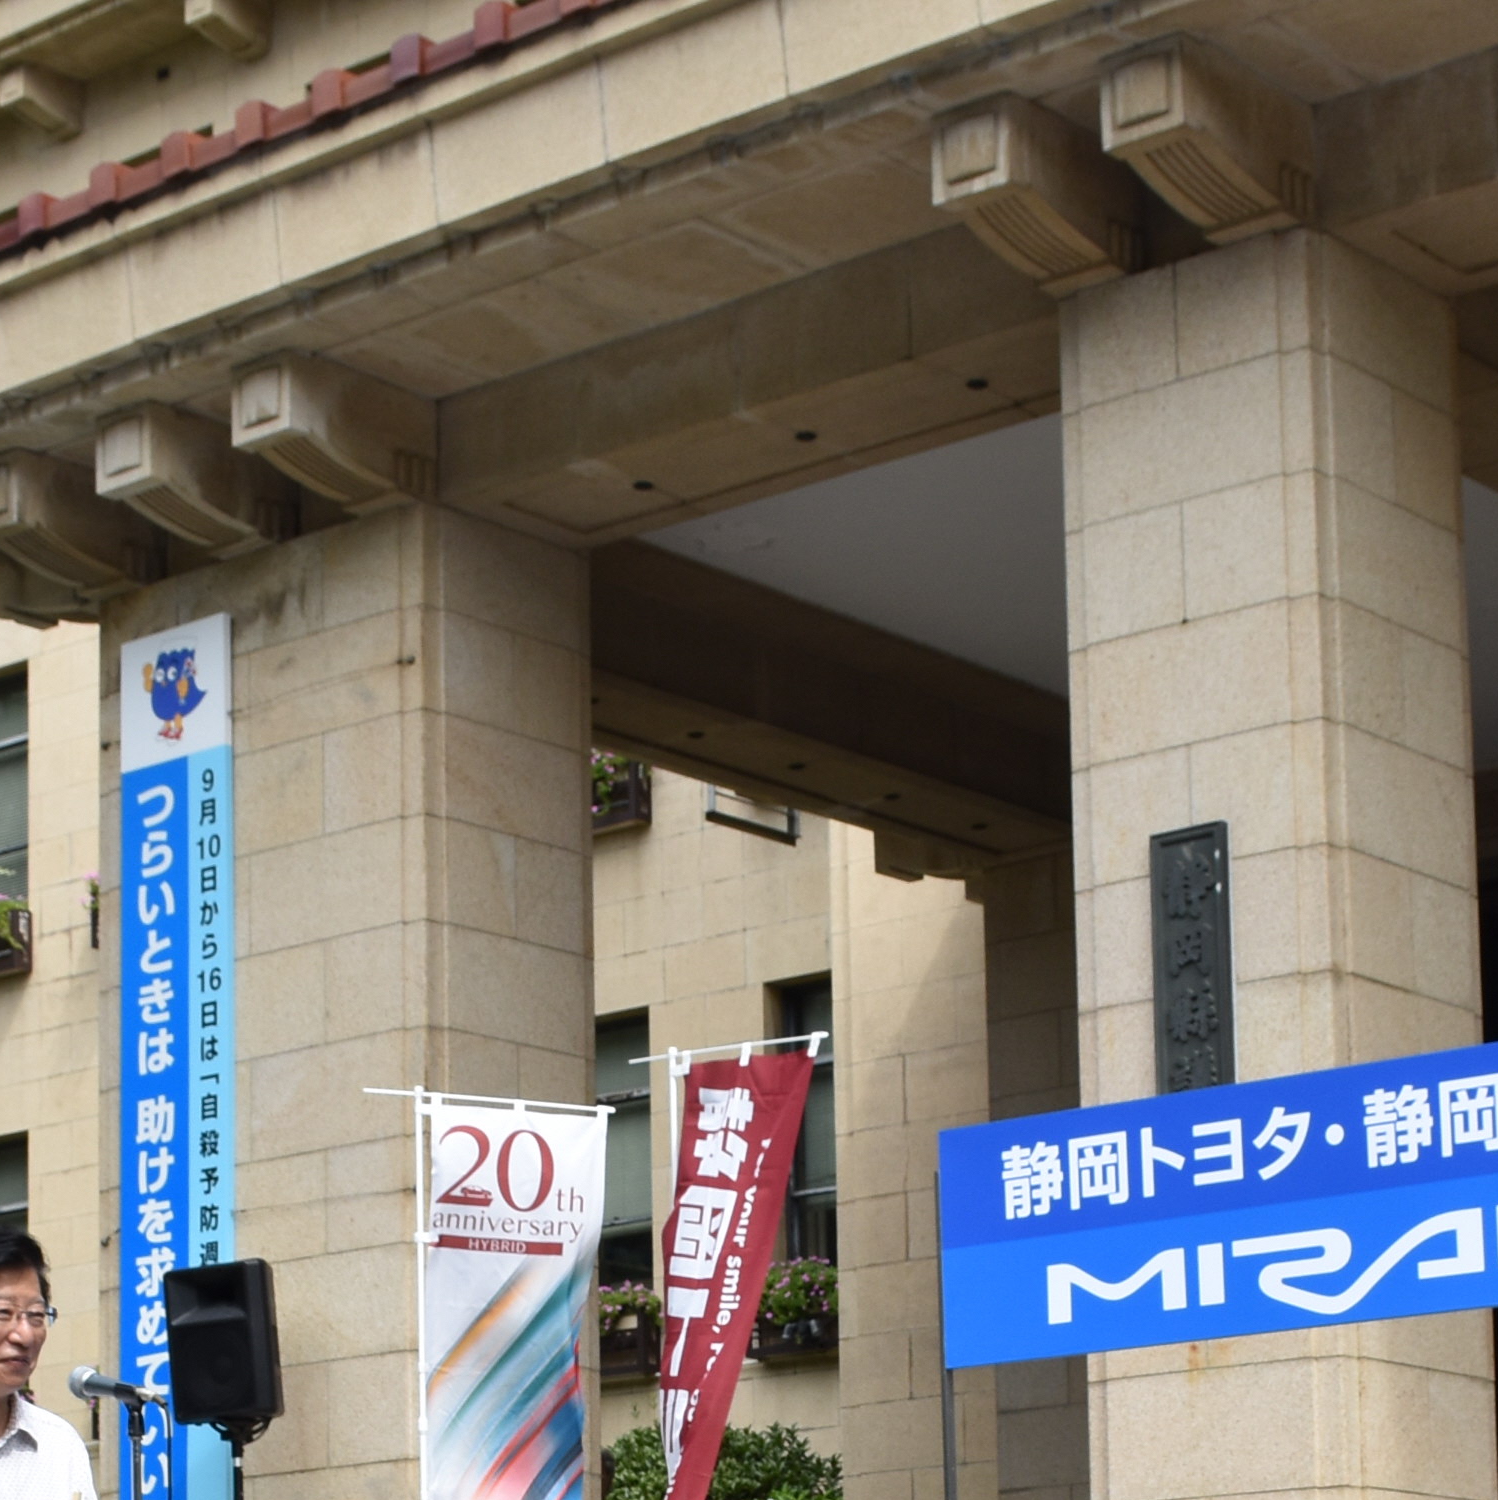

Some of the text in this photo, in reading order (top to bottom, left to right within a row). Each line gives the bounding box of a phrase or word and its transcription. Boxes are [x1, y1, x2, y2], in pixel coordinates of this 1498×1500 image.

[135, 783, 176, 1076] つらいときは
[432, 1210, 584, 1244] anniversary
[467, 1237, 528, 1254] HYBRID
[711, 1254, 743, 1335] smile,
